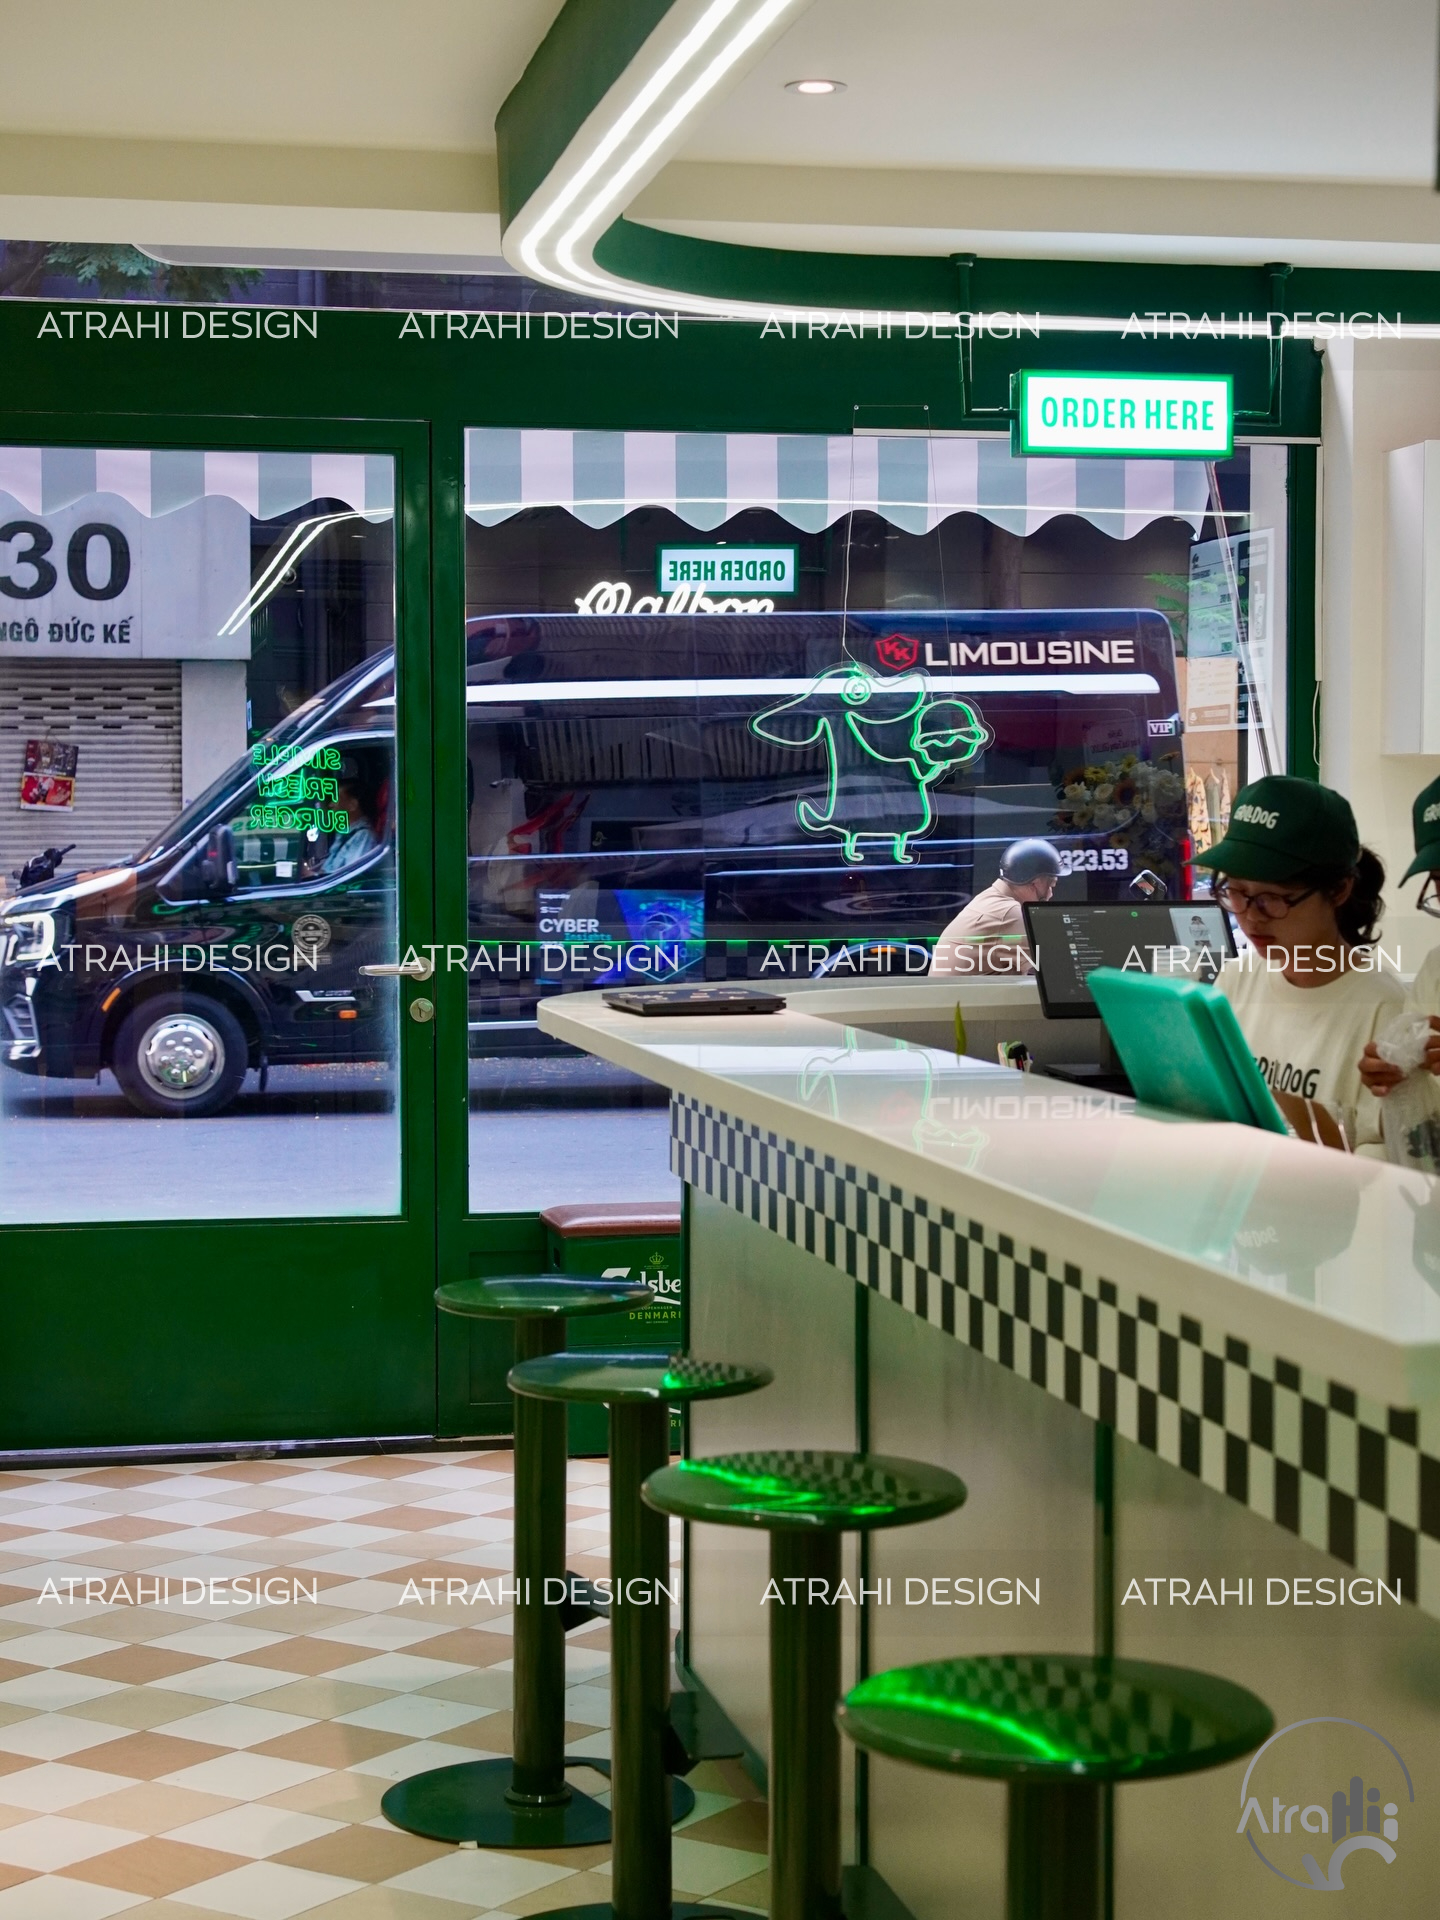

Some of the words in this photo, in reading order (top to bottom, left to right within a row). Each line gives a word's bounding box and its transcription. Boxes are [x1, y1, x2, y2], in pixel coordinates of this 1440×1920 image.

[1041, 396, 1136, 429] ORDER
[1145, 399, 1214, 431] HERE
[0, 520, 131, 601] 30
[925, 640, 1135, 666] LIMOUSINE
[1149, 723, 1173, 733] VIP
[539, 918, 600, 933] CYBER
